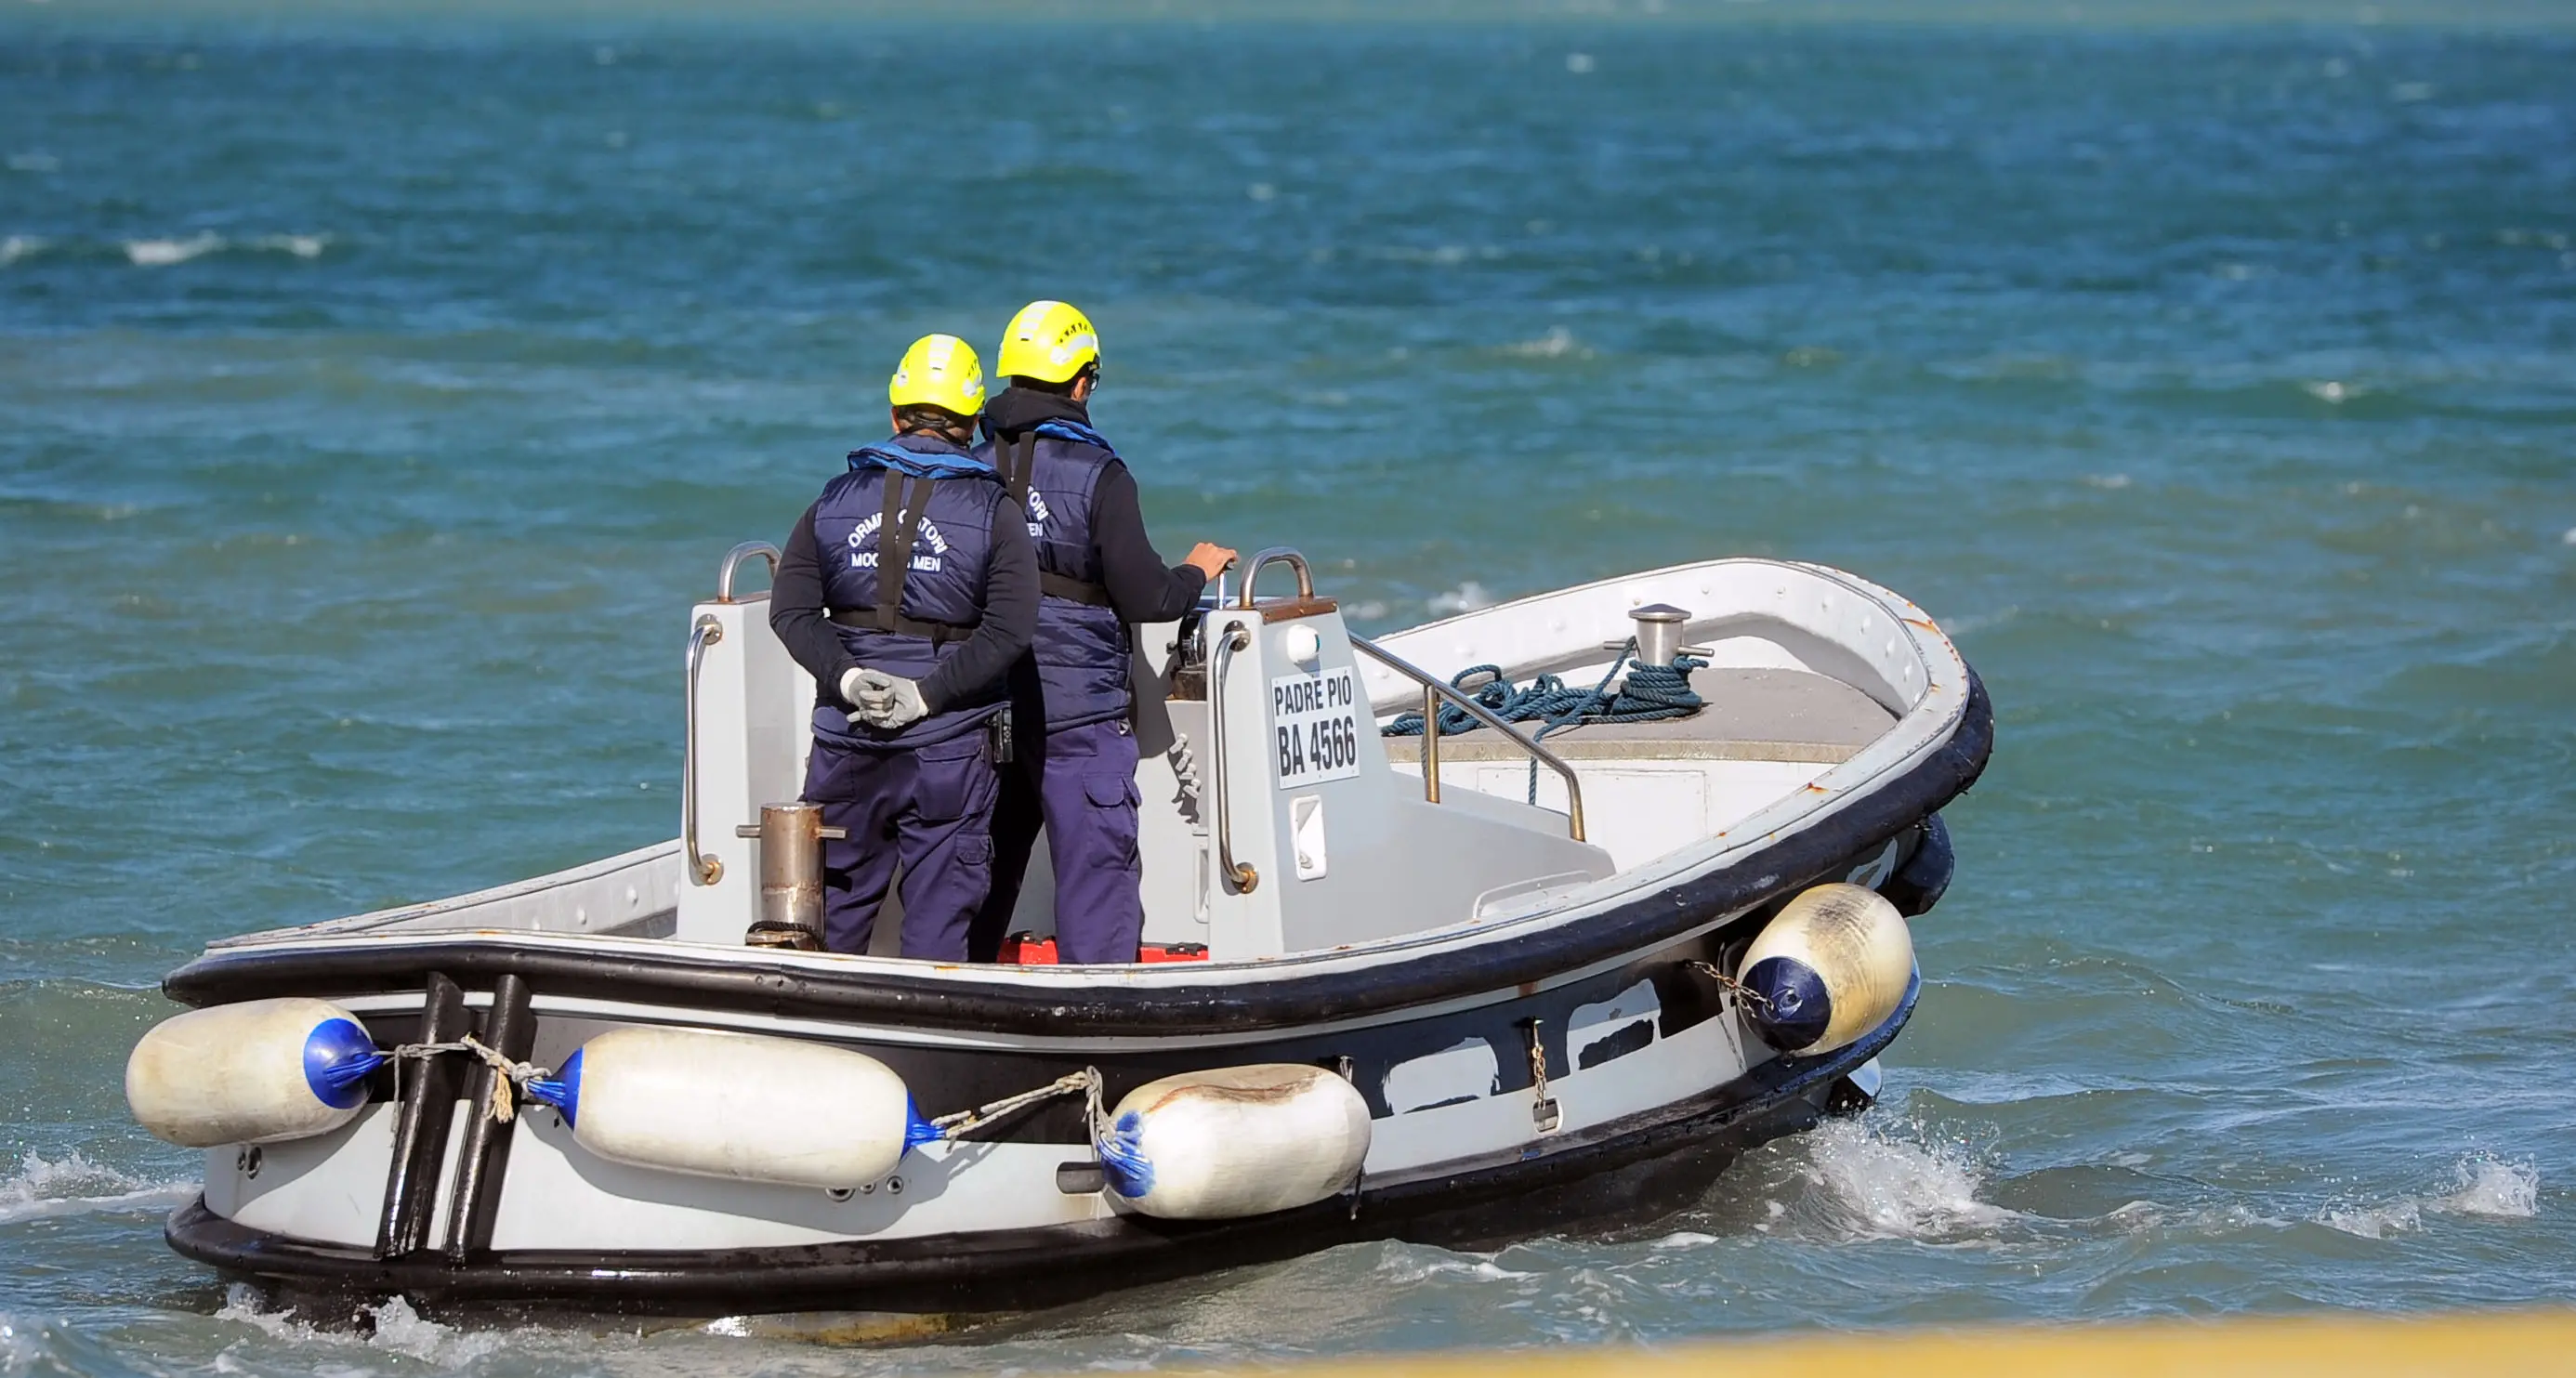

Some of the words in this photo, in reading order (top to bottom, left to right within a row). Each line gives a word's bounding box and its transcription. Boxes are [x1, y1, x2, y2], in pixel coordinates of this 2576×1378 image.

[848, 508, 949, 555] ORMTORI
[1026, 522, 1044, 537] EN
[913, 555, 941, 572] MEN
[1274, 679, 1323, 716] PADRE
[1327, 675, 1352, 708] PIO
[1278, 723, 1306, 777] BA
[1310, 715, 1356, 771] 4566
